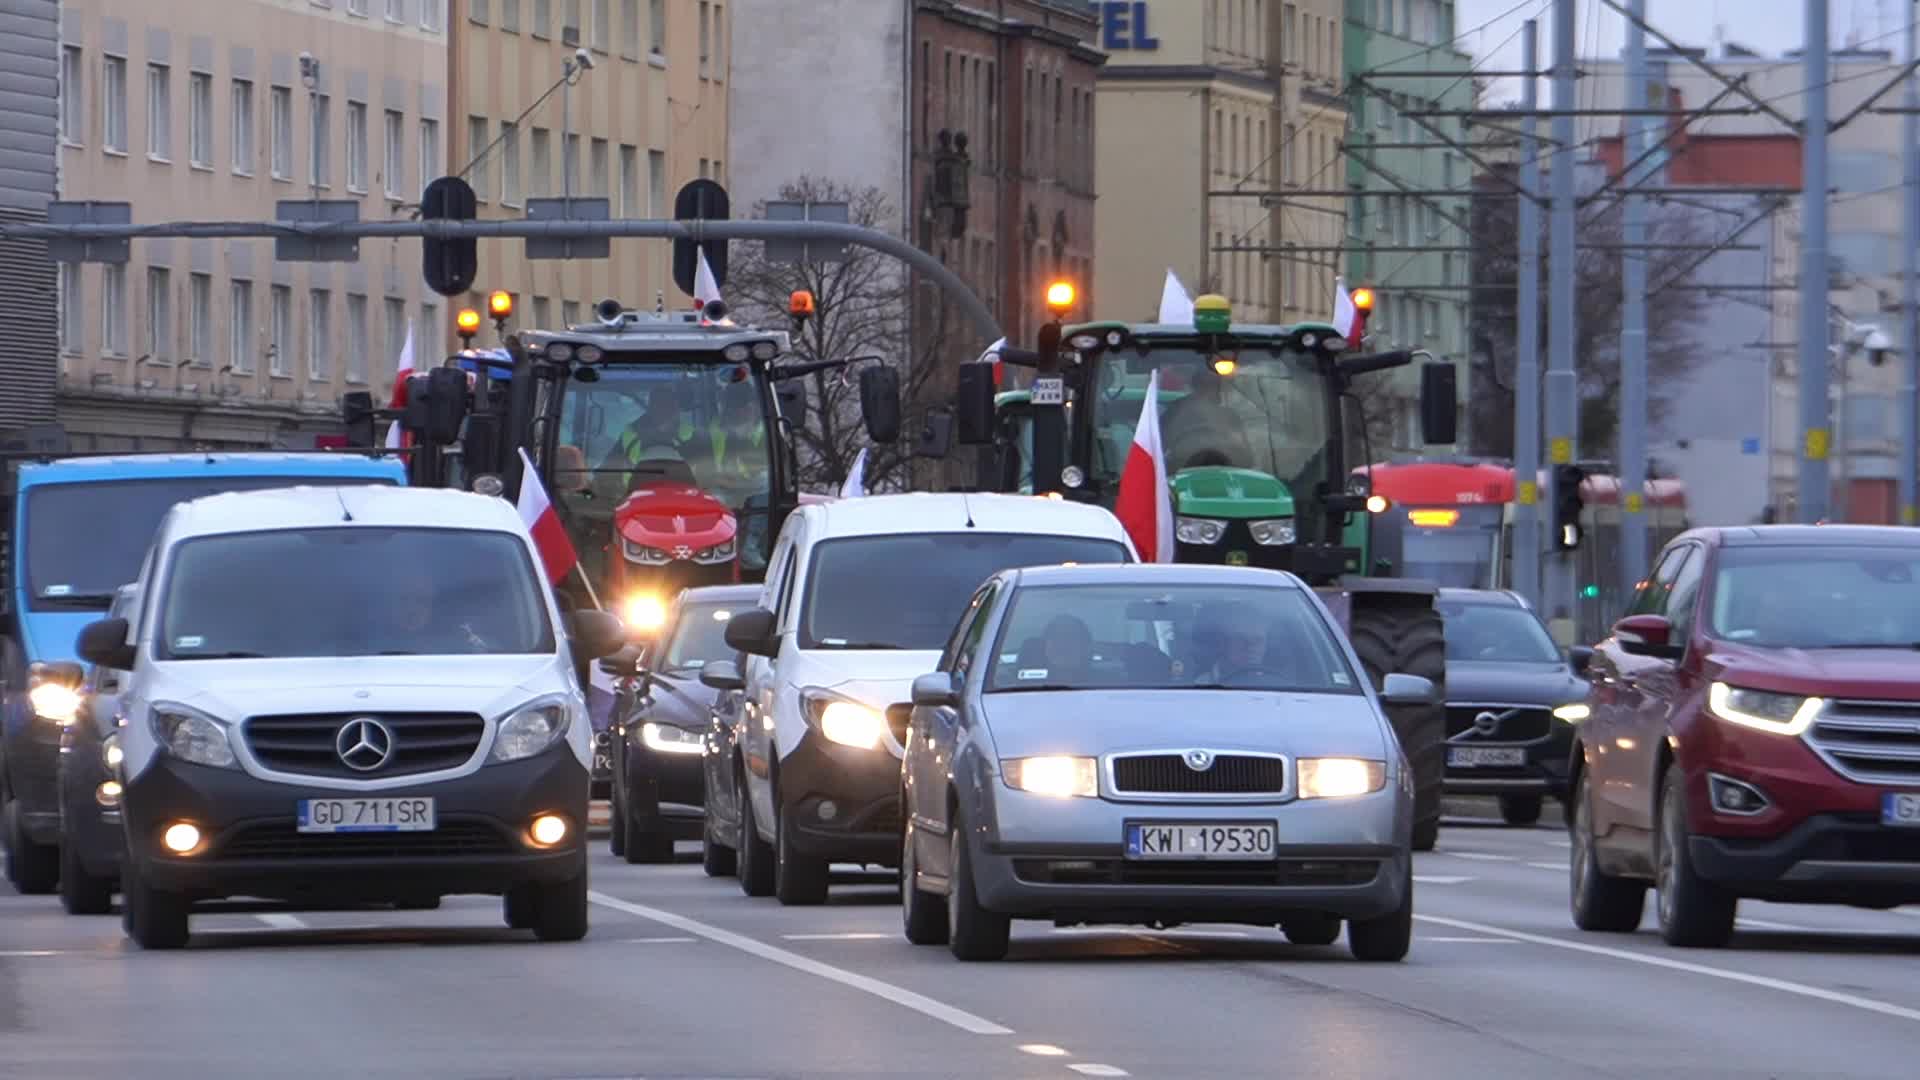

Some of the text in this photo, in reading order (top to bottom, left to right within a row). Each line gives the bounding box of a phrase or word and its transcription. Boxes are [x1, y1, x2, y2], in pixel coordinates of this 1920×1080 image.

[313, 800, 427, 825] GD 711SR
[1141, 828, 1271, 852] KWI 19530
